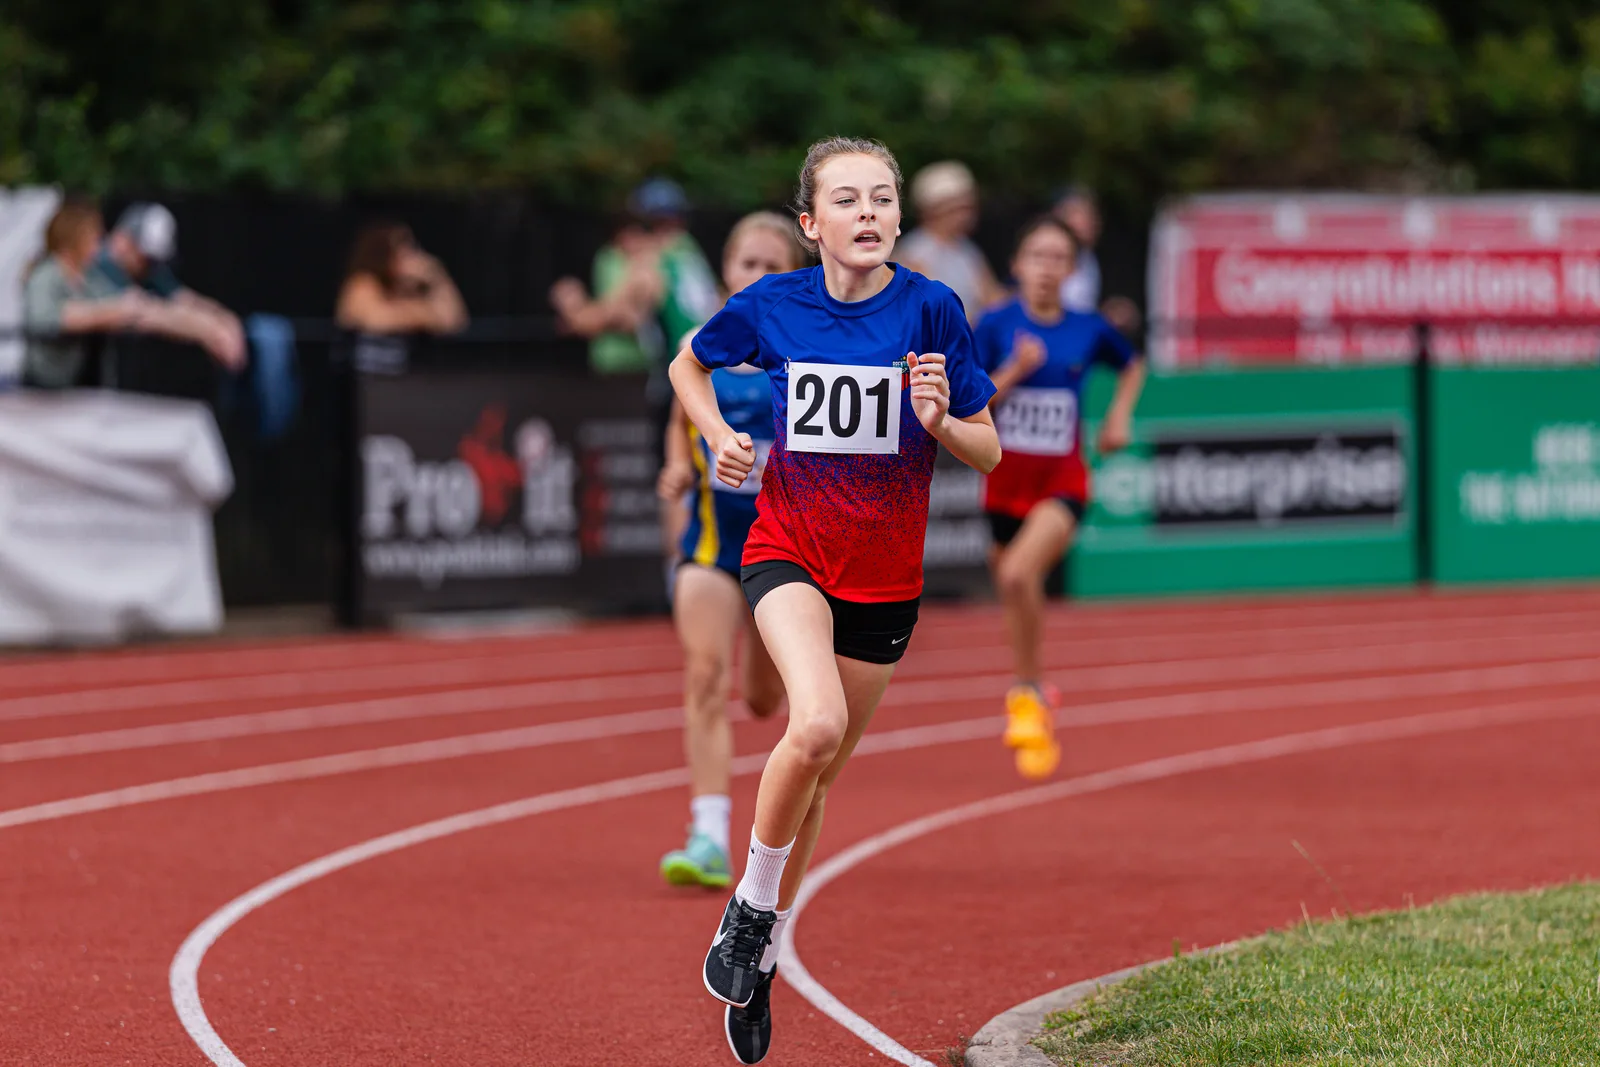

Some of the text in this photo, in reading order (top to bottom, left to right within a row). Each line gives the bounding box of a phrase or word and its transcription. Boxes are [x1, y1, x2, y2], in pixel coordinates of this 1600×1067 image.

[1213, 250, 1558, 328] Congratulations
[794, 374, 889, 438] 201
[1097, 434, 1402, 524] enterprise
